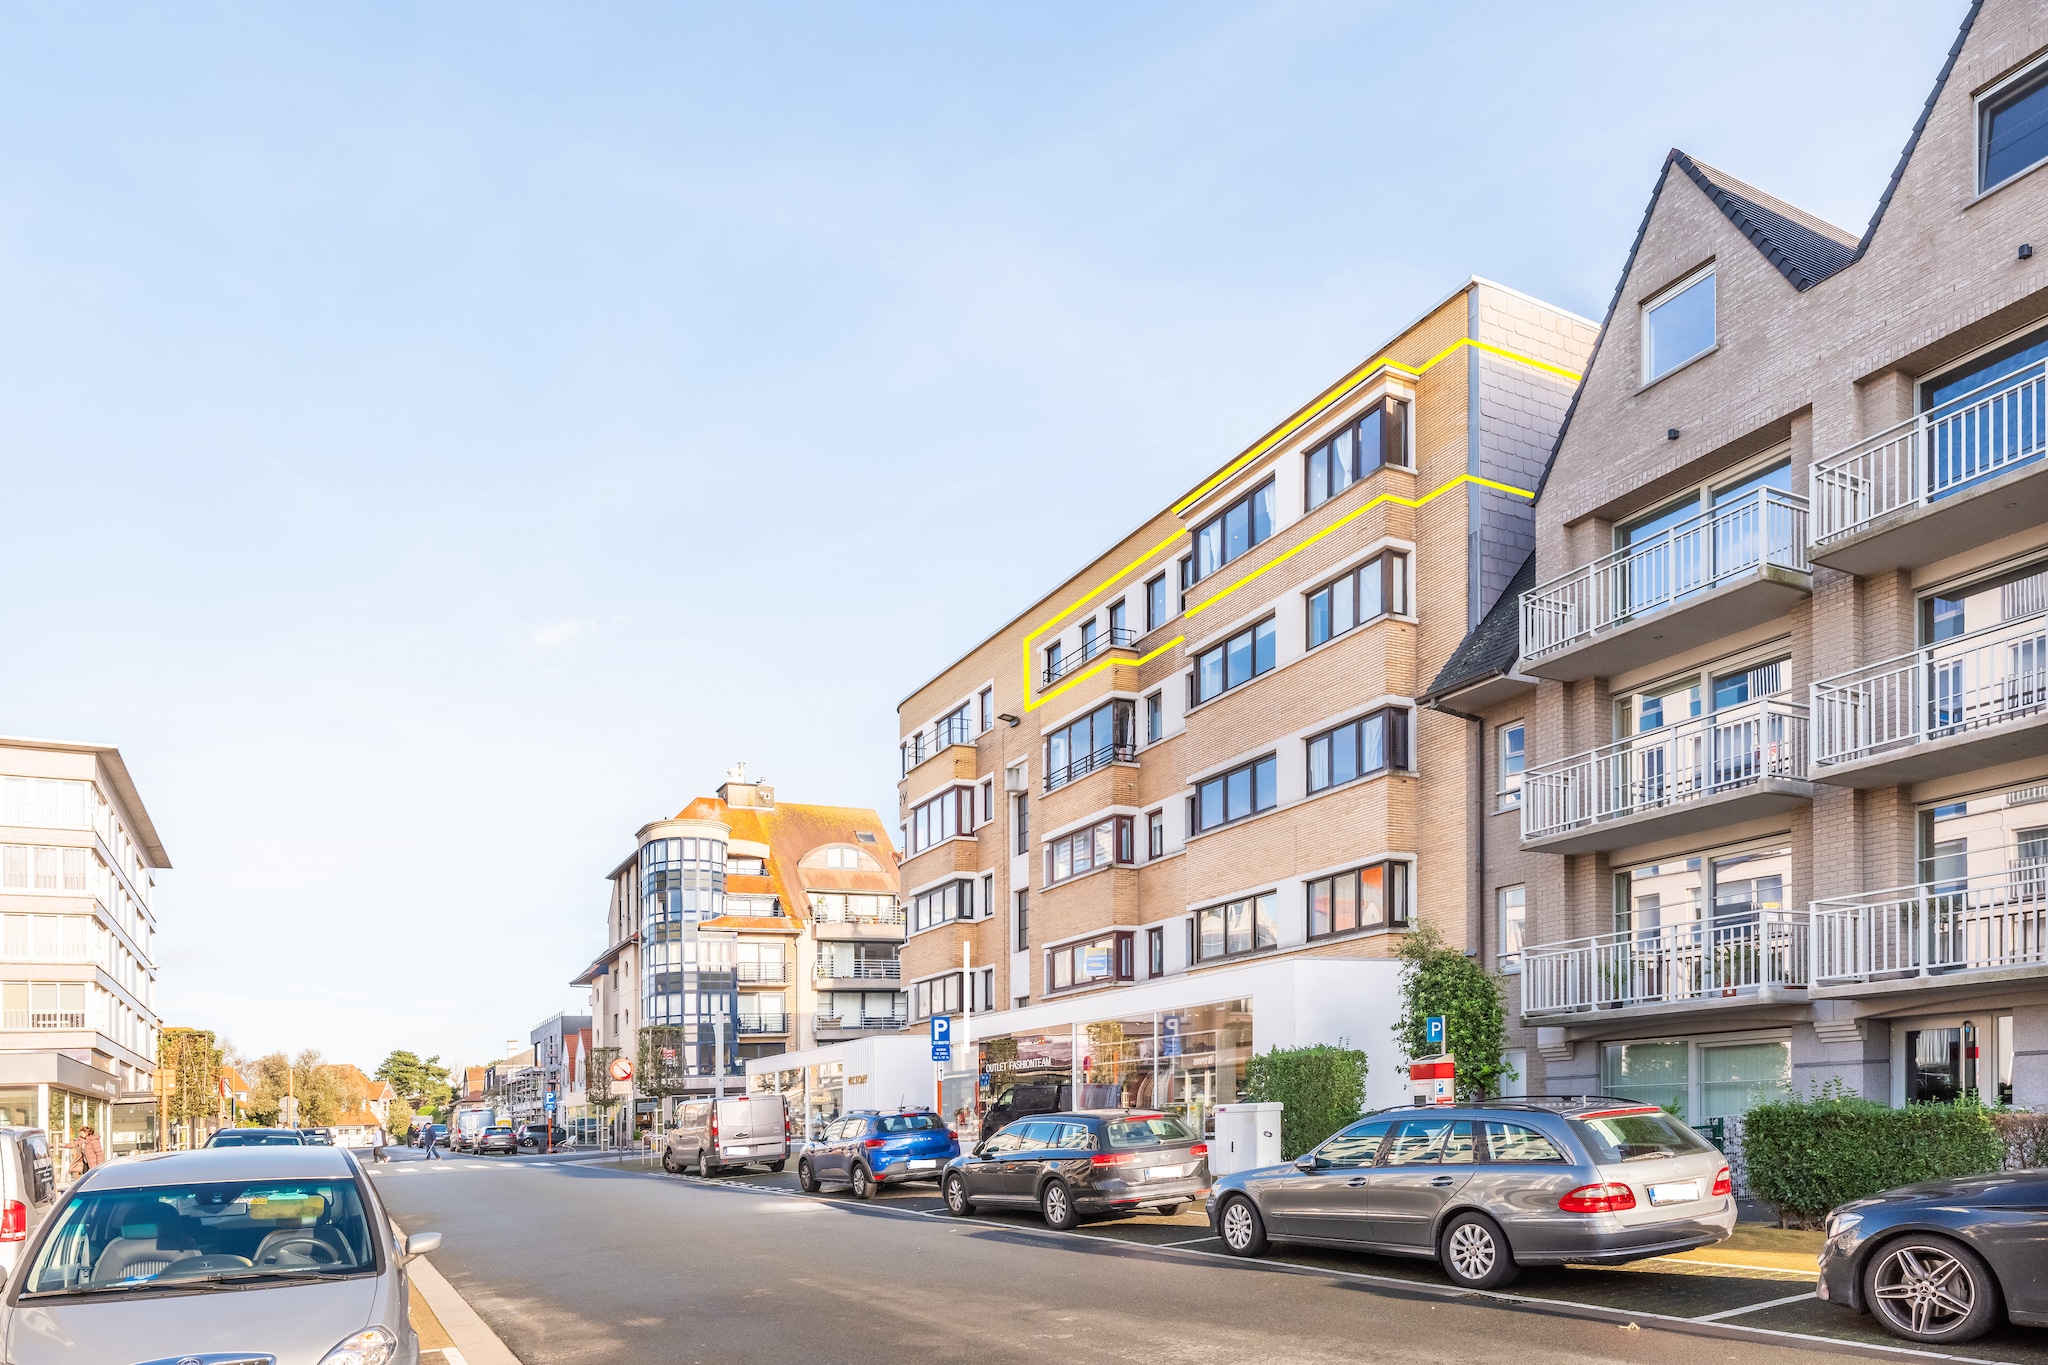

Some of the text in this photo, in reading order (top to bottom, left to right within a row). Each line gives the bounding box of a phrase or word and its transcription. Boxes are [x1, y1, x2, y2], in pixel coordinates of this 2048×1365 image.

[934, 1020, 948, 1041] P
[1432, 1022, 1441, 1037] P
[985, 1057, 1052, 1073] OUTLET FASHIONTEAM
[547, 1093, 554, 1102] P
